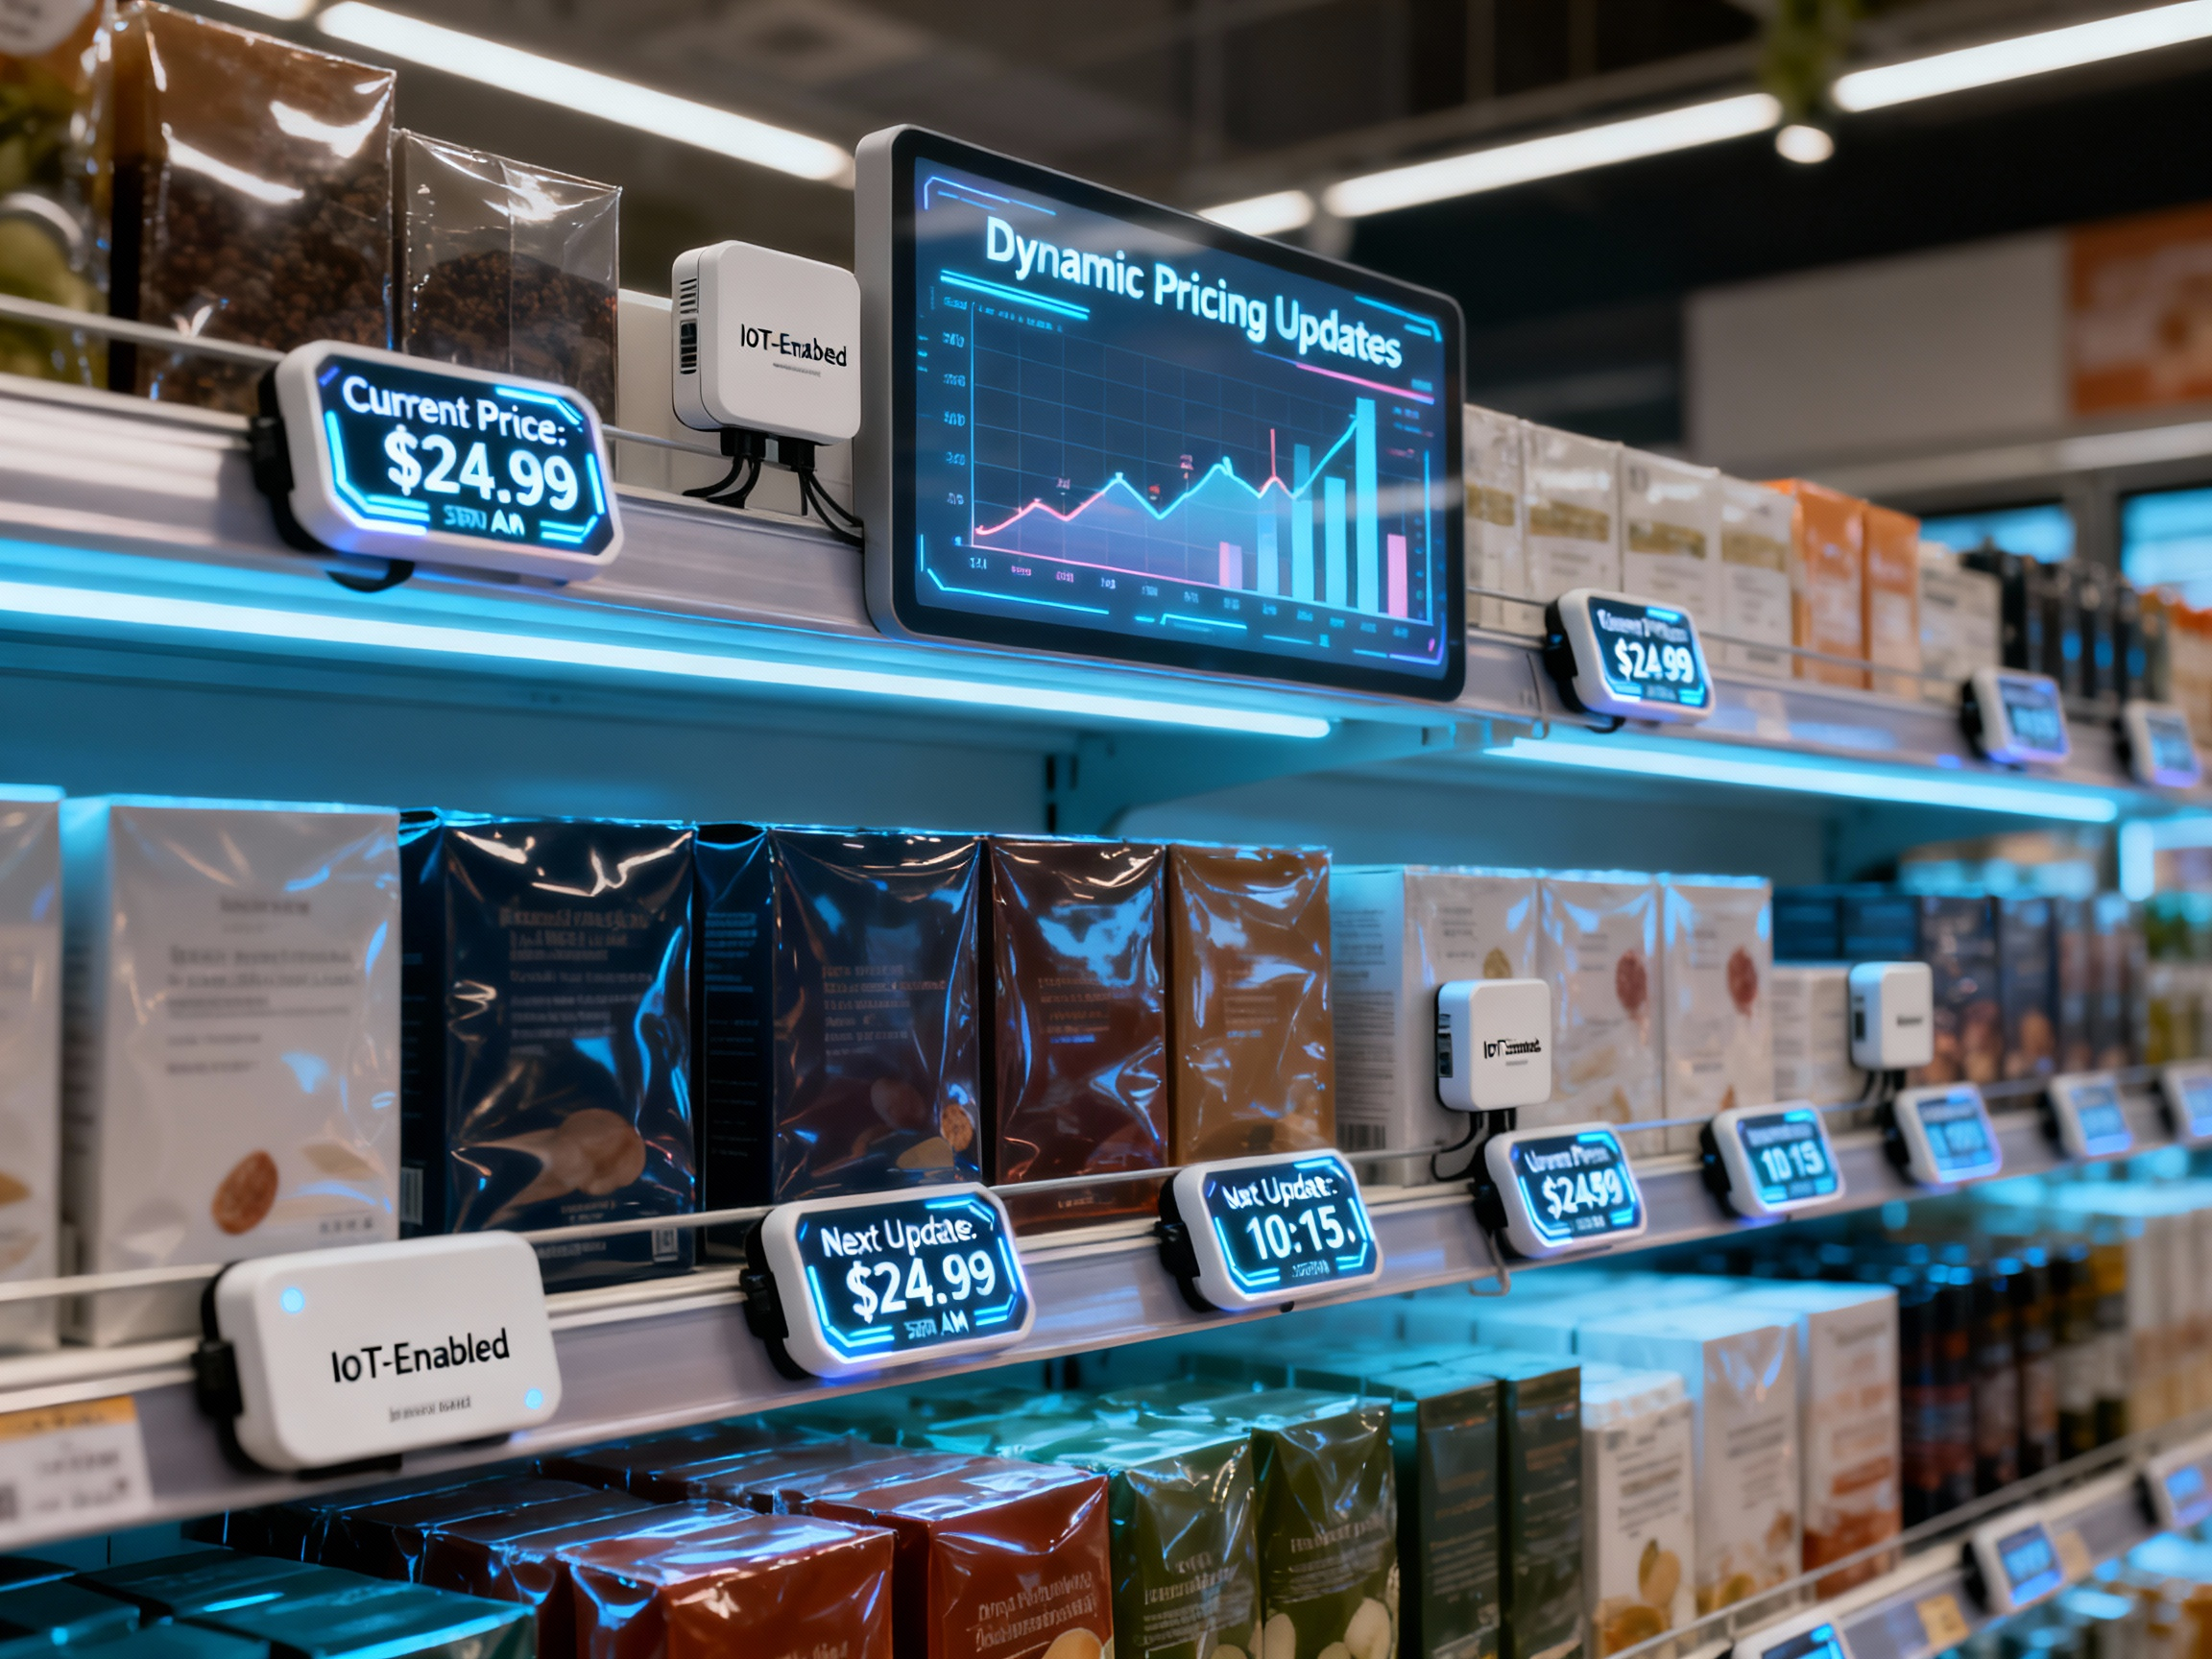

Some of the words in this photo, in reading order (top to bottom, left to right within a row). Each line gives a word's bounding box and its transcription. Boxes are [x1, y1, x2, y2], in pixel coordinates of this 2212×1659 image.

[986, 216, 1144, 299] Dynamic
[1154, 262, 1267, 343] Pricing
[1274, 295, 1404, 369] Updates
[342, 374, 470, 429] Current
[477, 398, 567, 447] Price:
[384, 423, 579, 512] $24.99
[820, 1223, 883, 1258] Next
[845, 1249, 997, 1324] $24.99
[330, 1326, 511, 1383] IoT-Enabled
